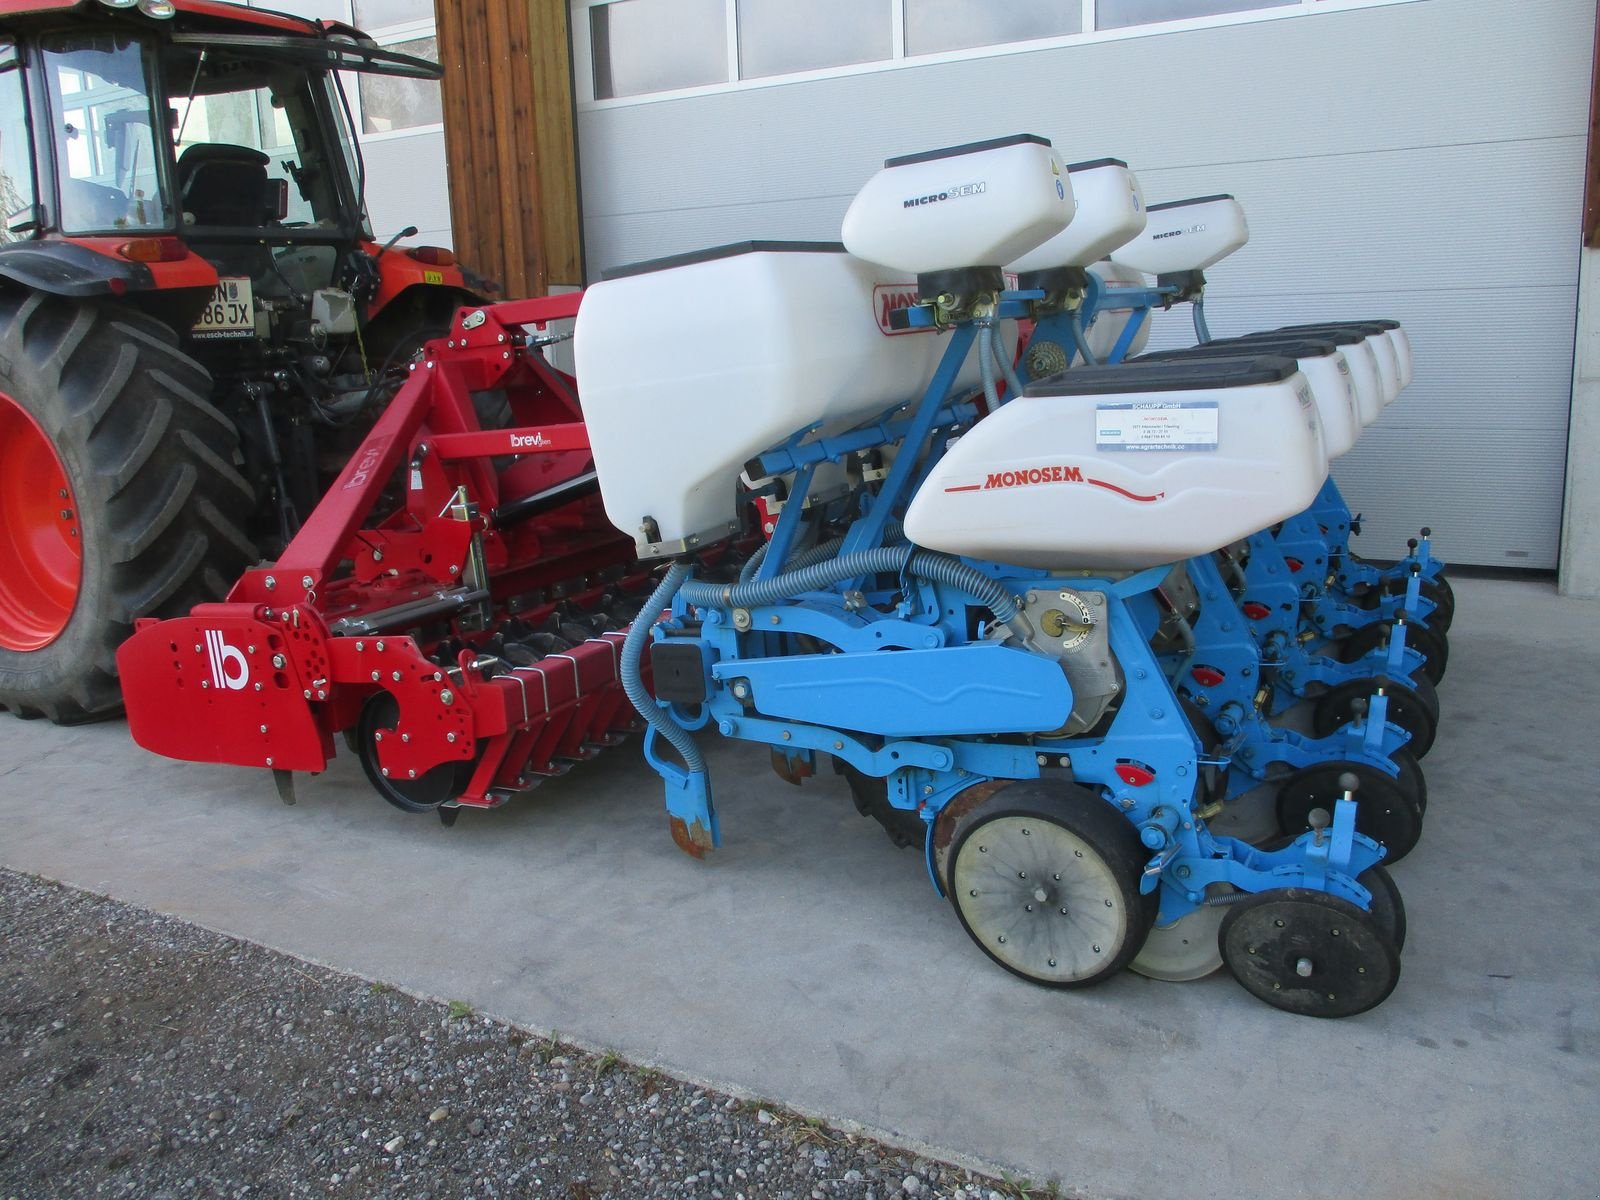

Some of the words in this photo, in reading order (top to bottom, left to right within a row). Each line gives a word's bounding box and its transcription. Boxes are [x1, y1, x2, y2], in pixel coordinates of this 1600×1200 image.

[903, 181, 986, 209] MICROSEM
[194, 303, 225, 325] 86
[227, 303, 249, 325] JX
[1163, 401, 1182, 409] GmbH
[510, 431, 542, 447] brevi
[984, 466, 1084, 489] MONOSEM
